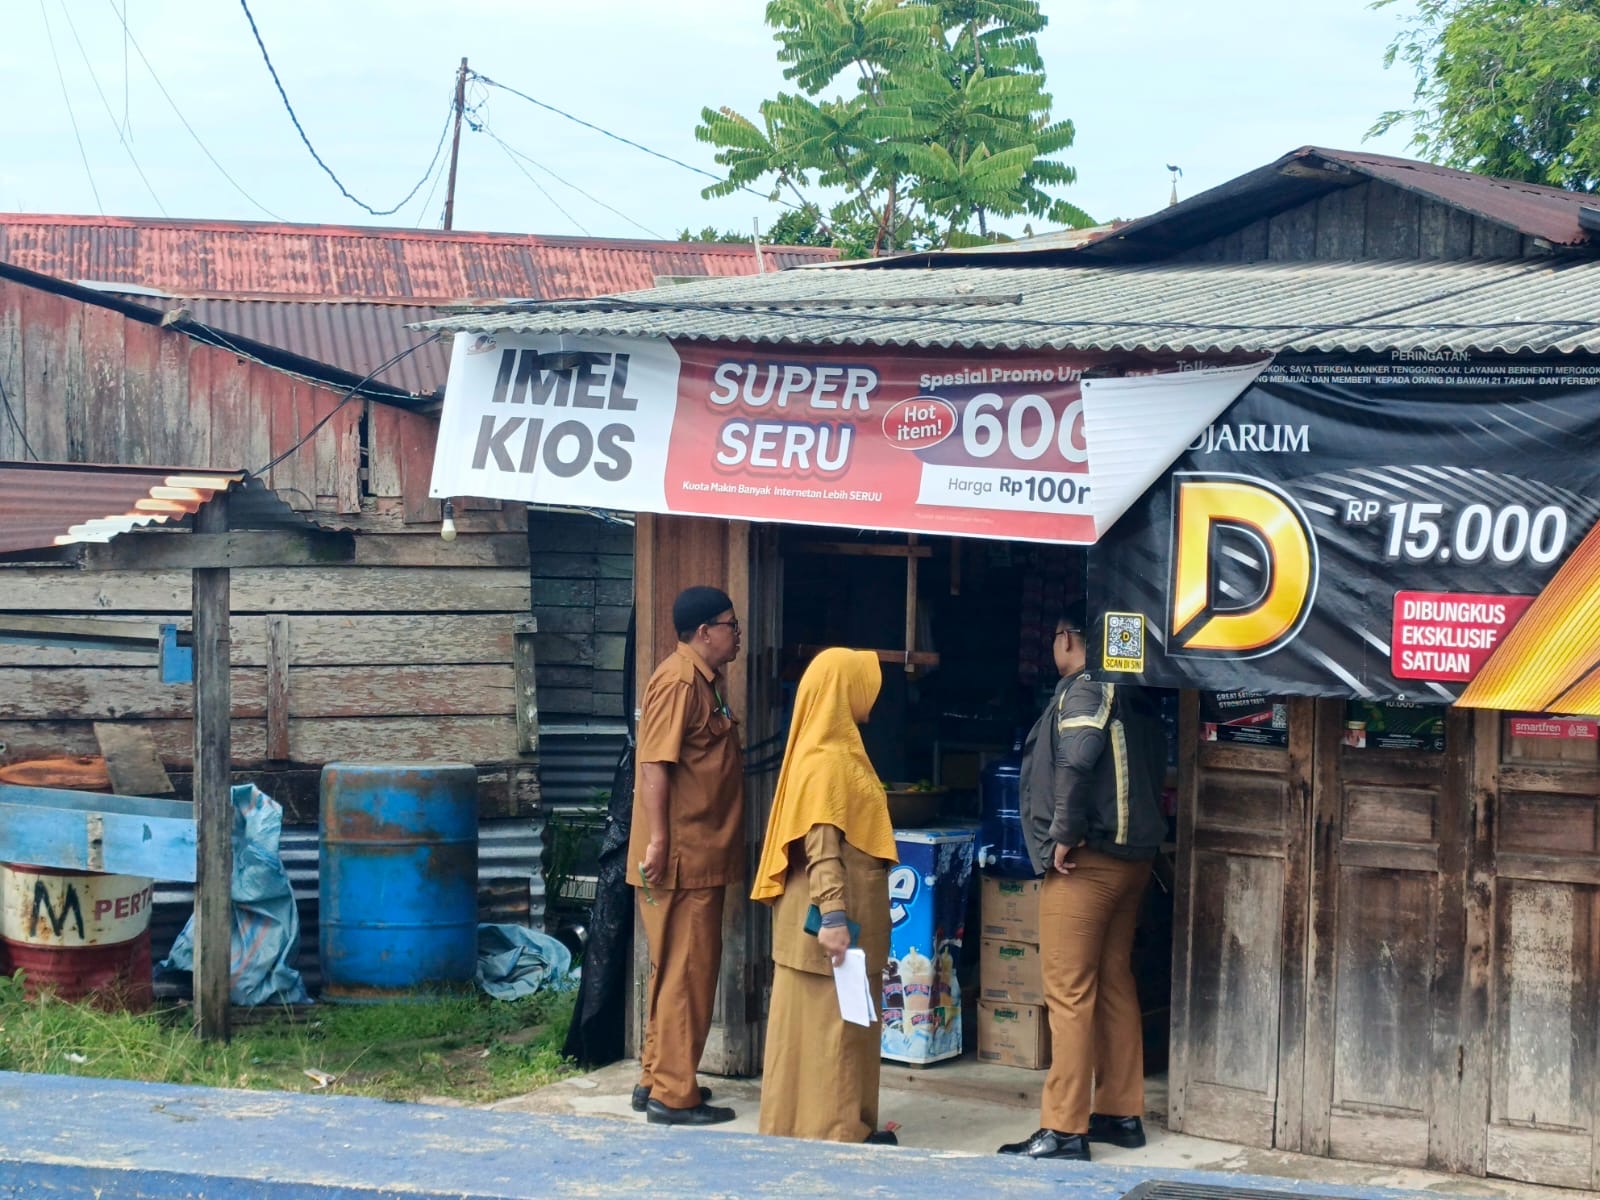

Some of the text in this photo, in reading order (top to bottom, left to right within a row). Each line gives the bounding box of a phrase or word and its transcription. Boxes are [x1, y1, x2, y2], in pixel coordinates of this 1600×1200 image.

[1391, 350, 1472, 362] PERINGATAN:
[492, 349, 638, 411] IMEL
[920, 366, 1090, 391] Spesial Promo Un
[1269, 375, 1310, 383] MENJUAL
[1311, 375, 1330, 383] DAN
[1331, 375, 1371, 384] MEMBERI
[1375, 376, 1410, 384] KEPADA
[1411, 376, 1444, 384] ORANG
[1456, 377, 1490, 385] BAWAH
[1491, 377, 1501, 385] 21
[1503, 377, 1535, 385] TAHUN
[1539, 377, 1559, 385] DAN
[1560, 376, 1600, 385] PEREMP
[1289, 365, 1312, 373] SAYA
[1313, 365, 1352, 374] TERKENA
[1354, 365, 1390, 374] KANKER
[1464, 366, 1506, 374] LAYANAN
[1508, 366, 1553, 374] BERHENTI
[710, 363, 878, 410] SUPER
[904, 405, 937, 423] Hot
[897, 419, 943, 441] item!
[472, 415, 635, 482] KIOS
[717, 423, 851, 471] SERU
[682, 481, 709, 492] Kuota
[711, 483, 737, 494] Makin
[738, 484, 771, 497] Banyak
[823, 489, 848, 500] Lebih
[948, 476, 1091, 505] Harga Rp100r
[1346, 500, 1567, 563] RP 15.000
[1173, 481, 1311, 650] D
[1403, 601, 1506, 624] DIBUNGKUS
[1402, 626, 1497, 649] EKSKLUSIF
[1105, 659, 1122, 668] SCAN
[1401, 650, 1470, 673] SATUAN
[1516, 722, 1560, 732] smartfren
